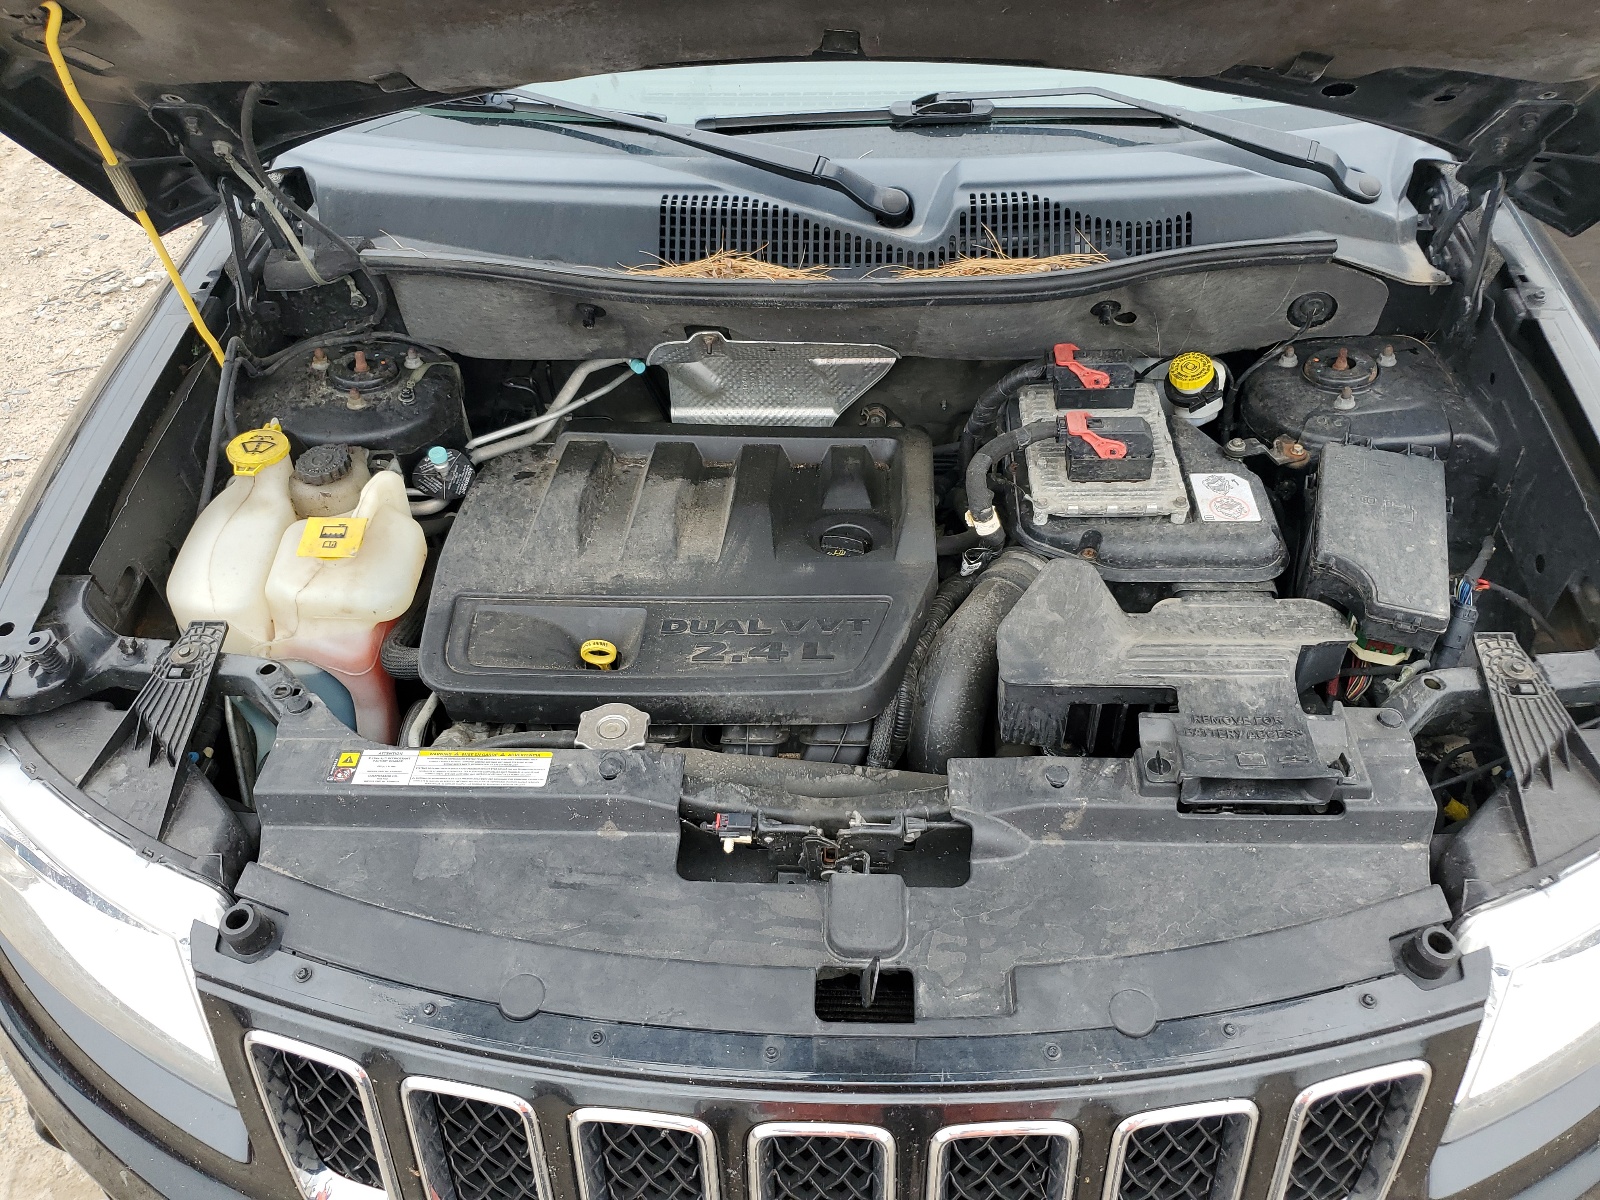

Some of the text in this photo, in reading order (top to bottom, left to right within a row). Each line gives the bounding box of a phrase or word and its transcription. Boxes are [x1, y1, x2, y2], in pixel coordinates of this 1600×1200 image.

[659, 618, 871, 636] DUAL VVT
[690, 641, 836, 664] 2.4 L
[1190, 715, 1283, 726] REMOVE FOR
[1183, 727, 1305, 740] BATTERY ACCESS
